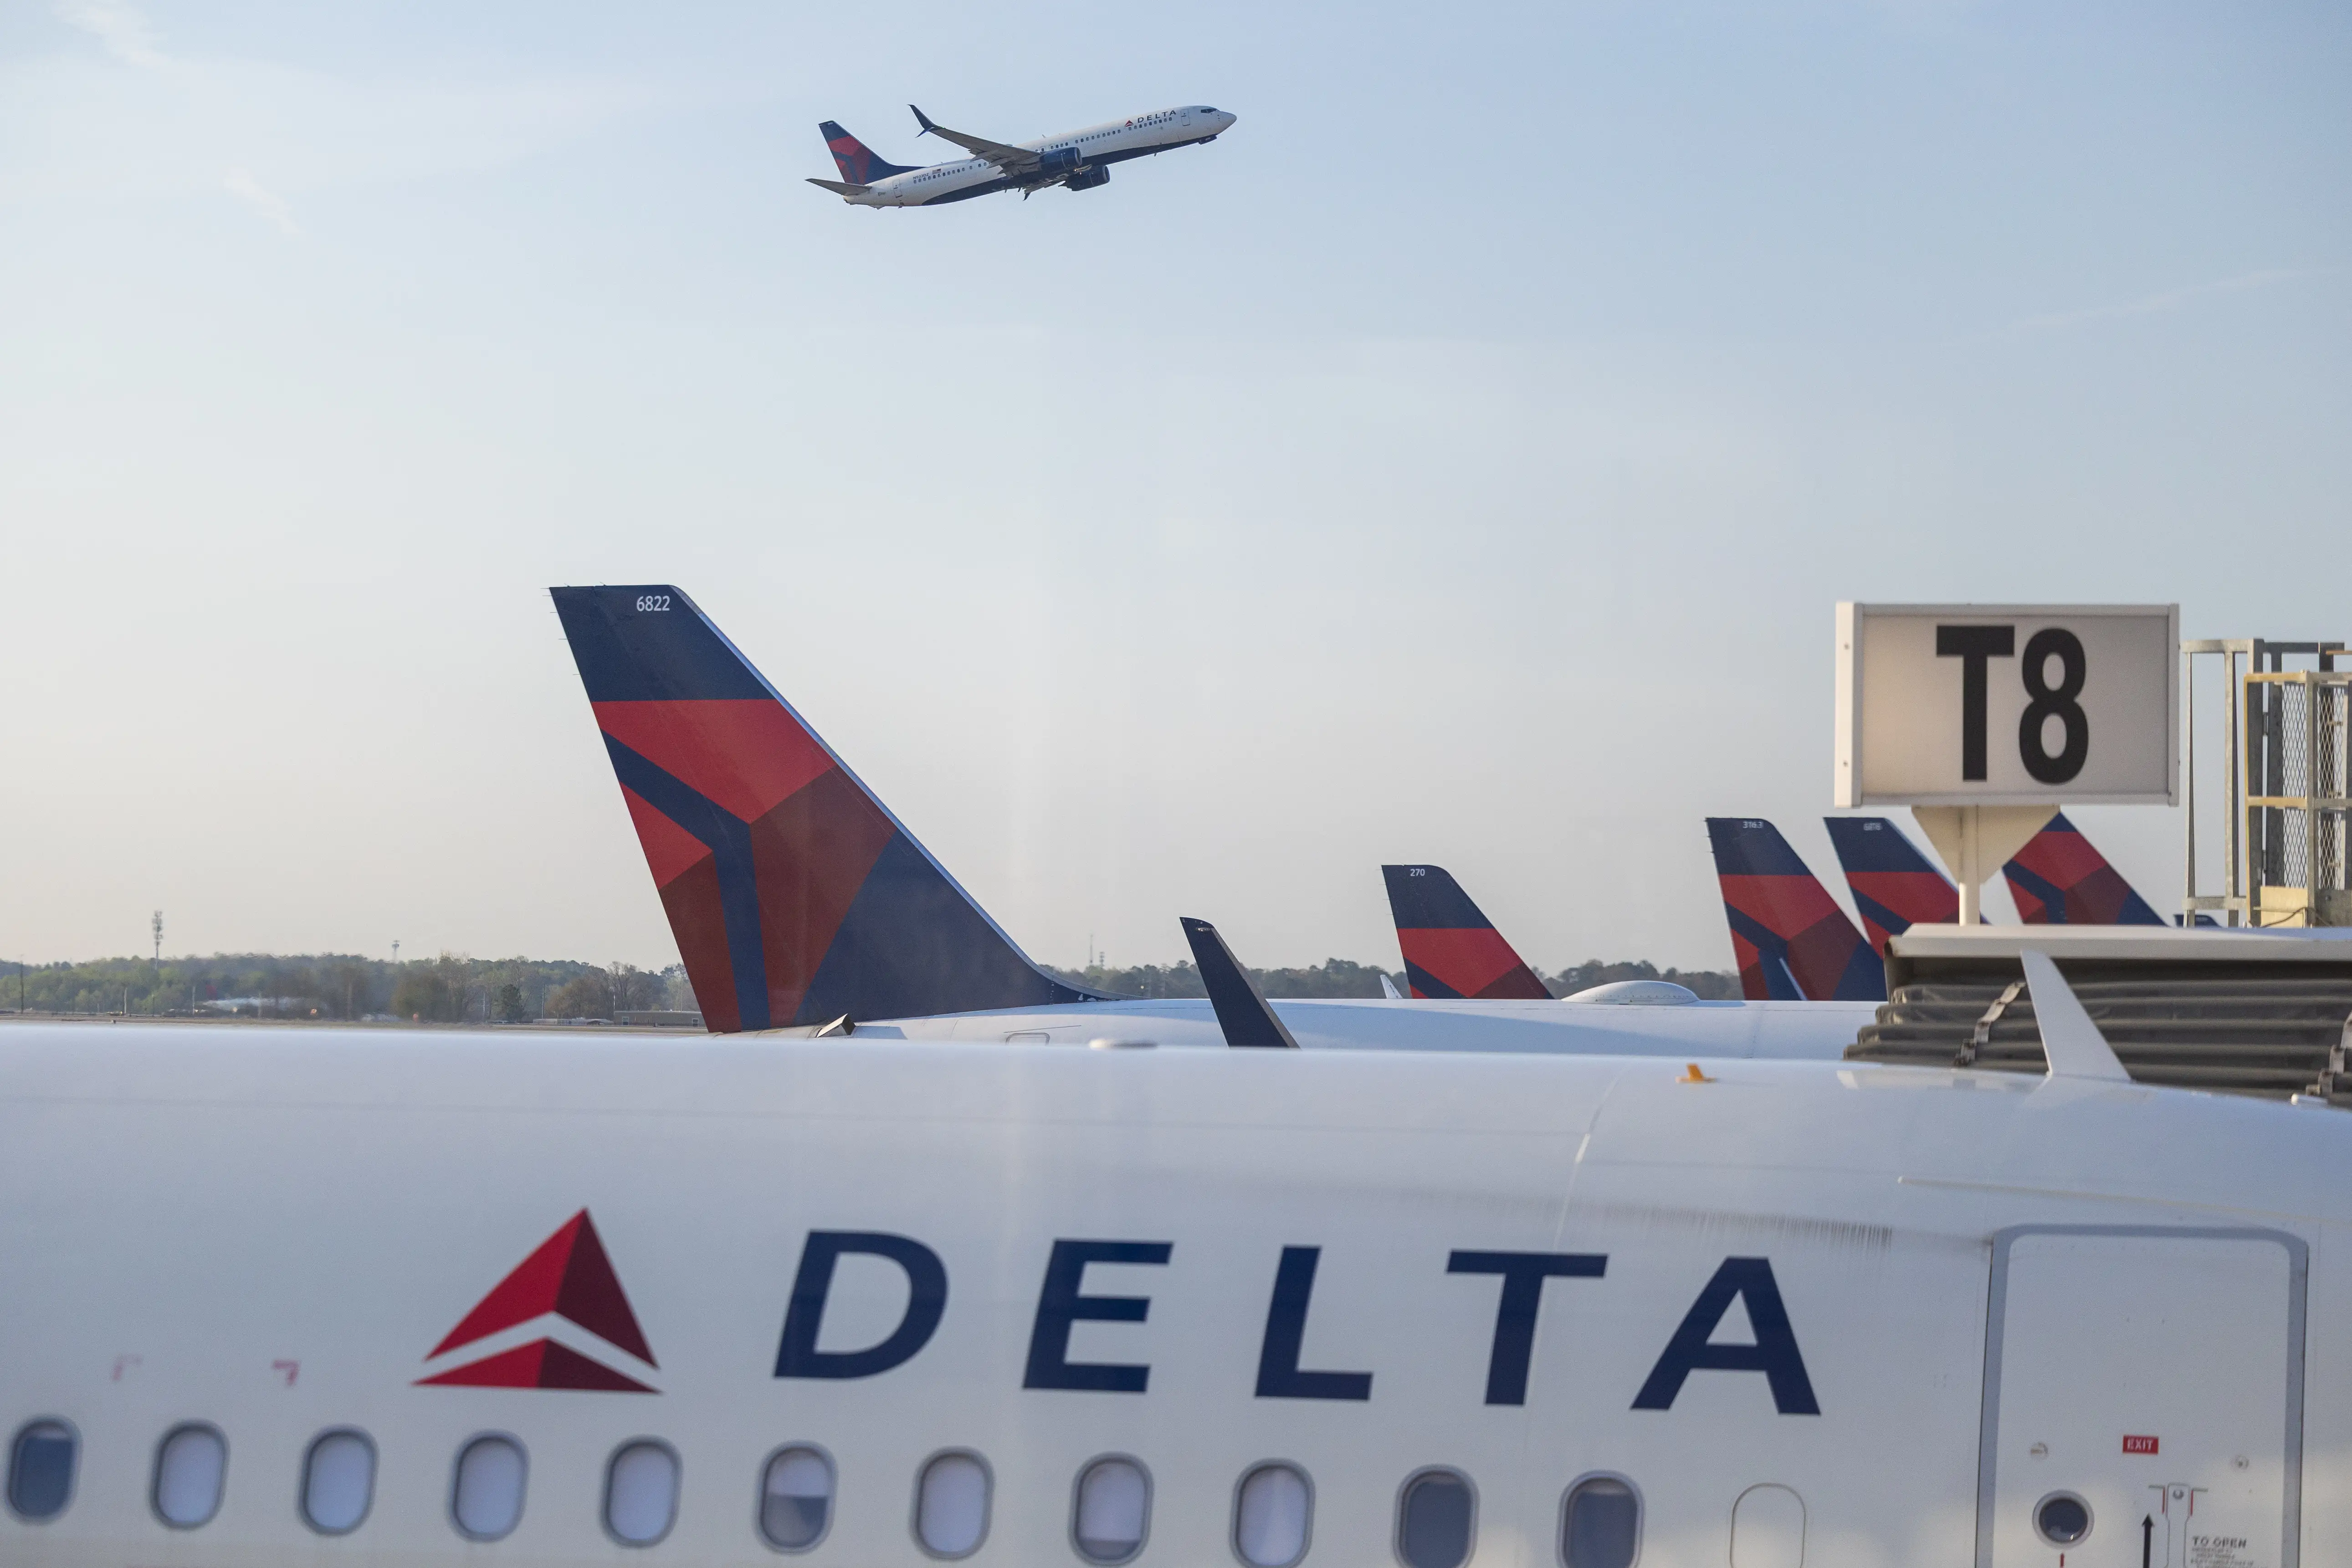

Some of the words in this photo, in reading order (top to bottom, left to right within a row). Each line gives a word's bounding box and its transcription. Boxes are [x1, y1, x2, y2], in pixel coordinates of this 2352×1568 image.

[1138, 110, 1176, 123] DELTA
[636, 595, 670, 611] 6822
[1936, 624, 2089, 786] T8
[1410, 868, 1425, 876] 270
[773, 1230, 1821, 1416] DELTA
[2127, 1437, 2154, 1450] EXIT
[2193, 1536, 2209, 1546] TO
[2213, 1537, 2247, 1548] OPEN
